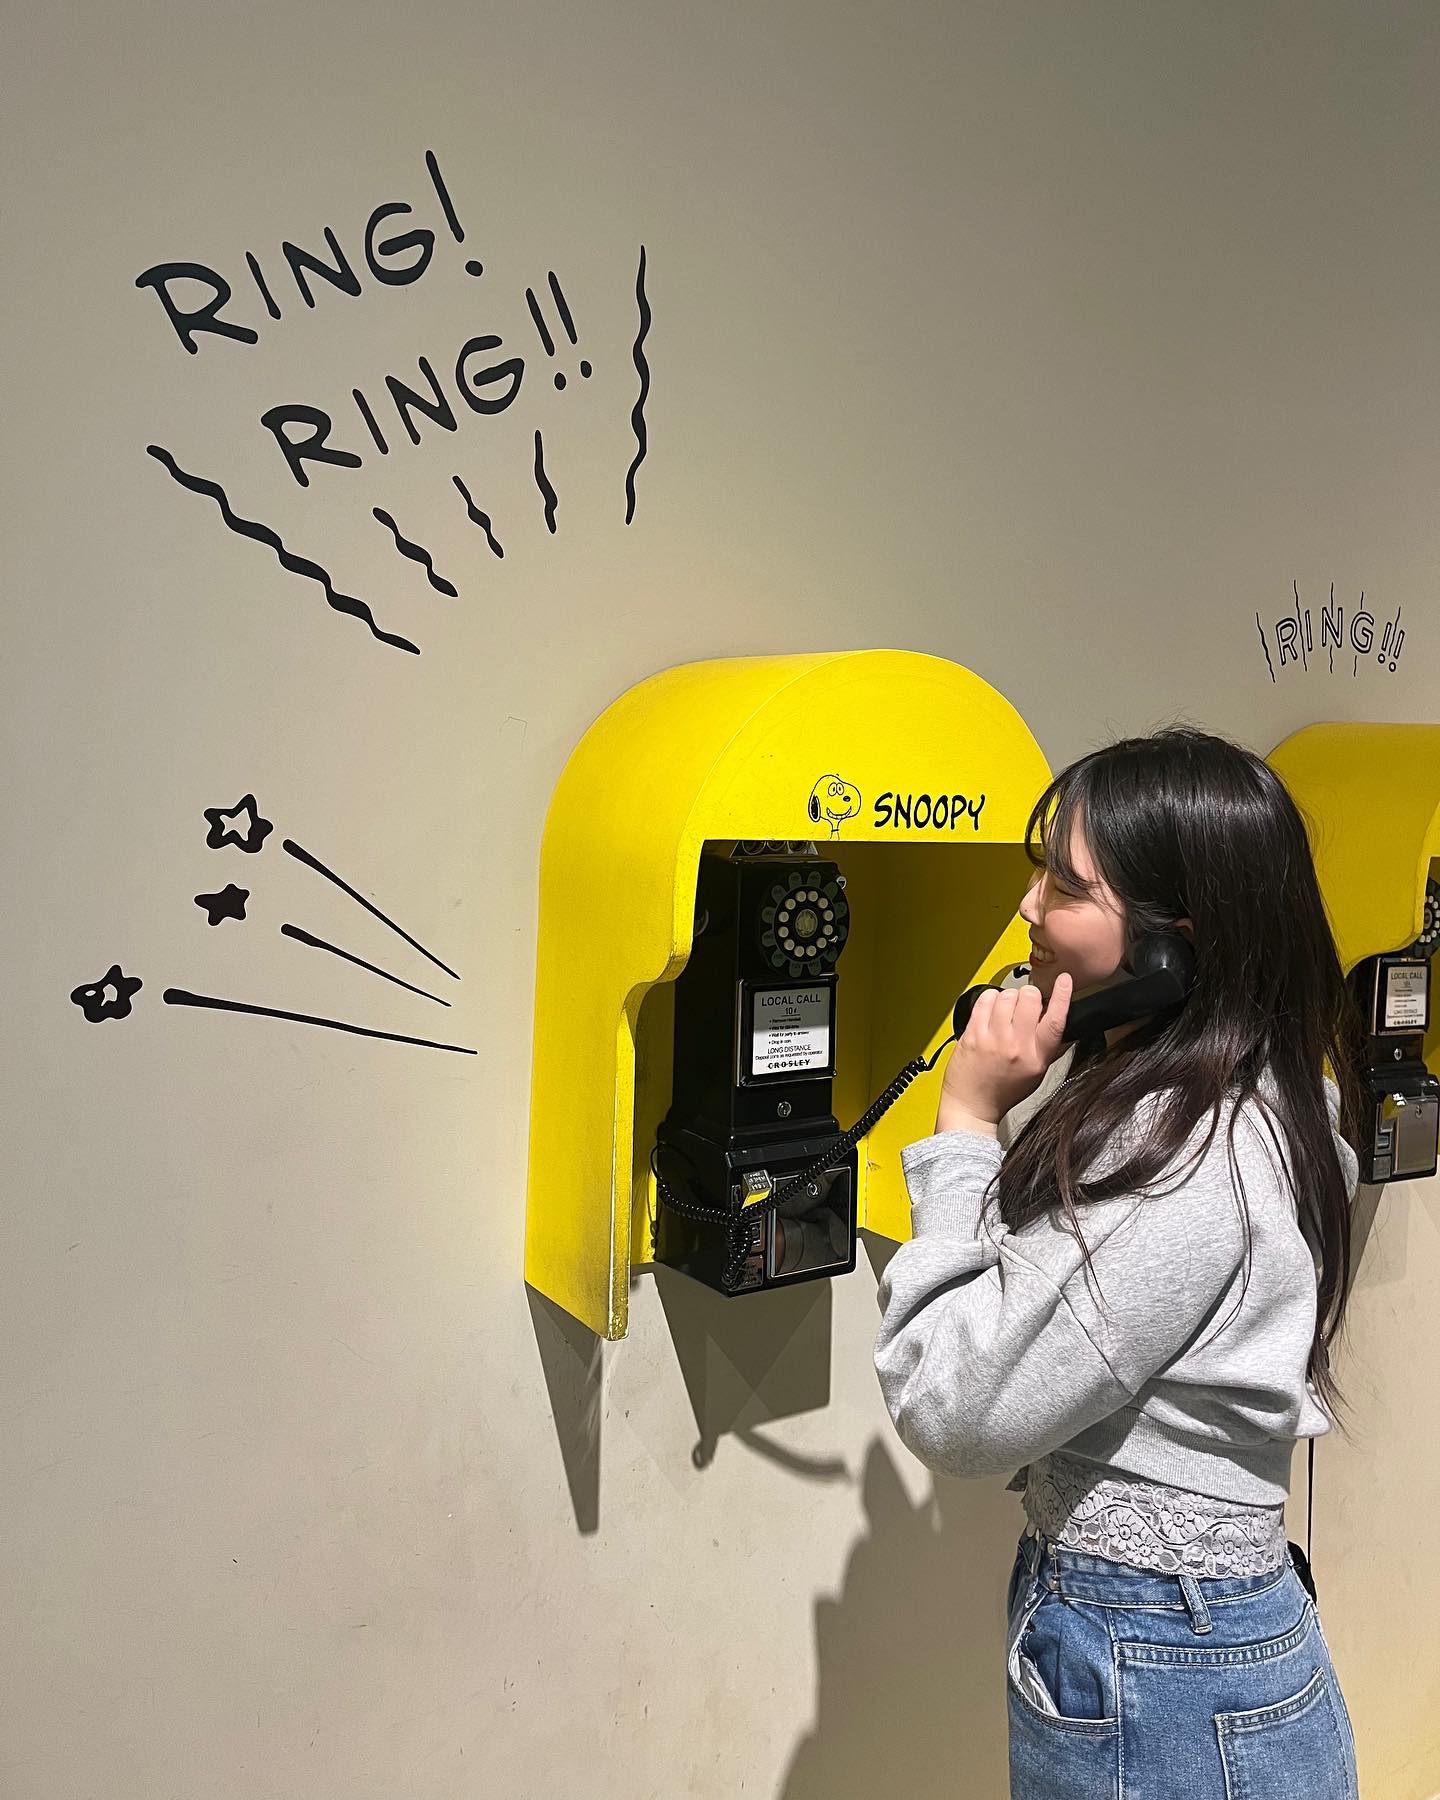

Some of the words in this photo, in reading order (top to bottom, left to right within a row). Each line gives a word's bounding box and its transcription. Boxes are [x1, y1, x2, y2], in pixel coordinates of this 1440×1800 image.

[135, 149, 484, 355] RING!
[260, 270, 593, 488] RING!!
[1275, 606, 1405, 673] RING!!
[873, 791, 986, 831] SNOOPY
[762, 996, 794, 1006] LOCAL
[796, 994, 821, 1004] CALL
[768, 1060, 810, 1069] CROSLEY
[784, 1044, 811, 1052] DISTANCE
